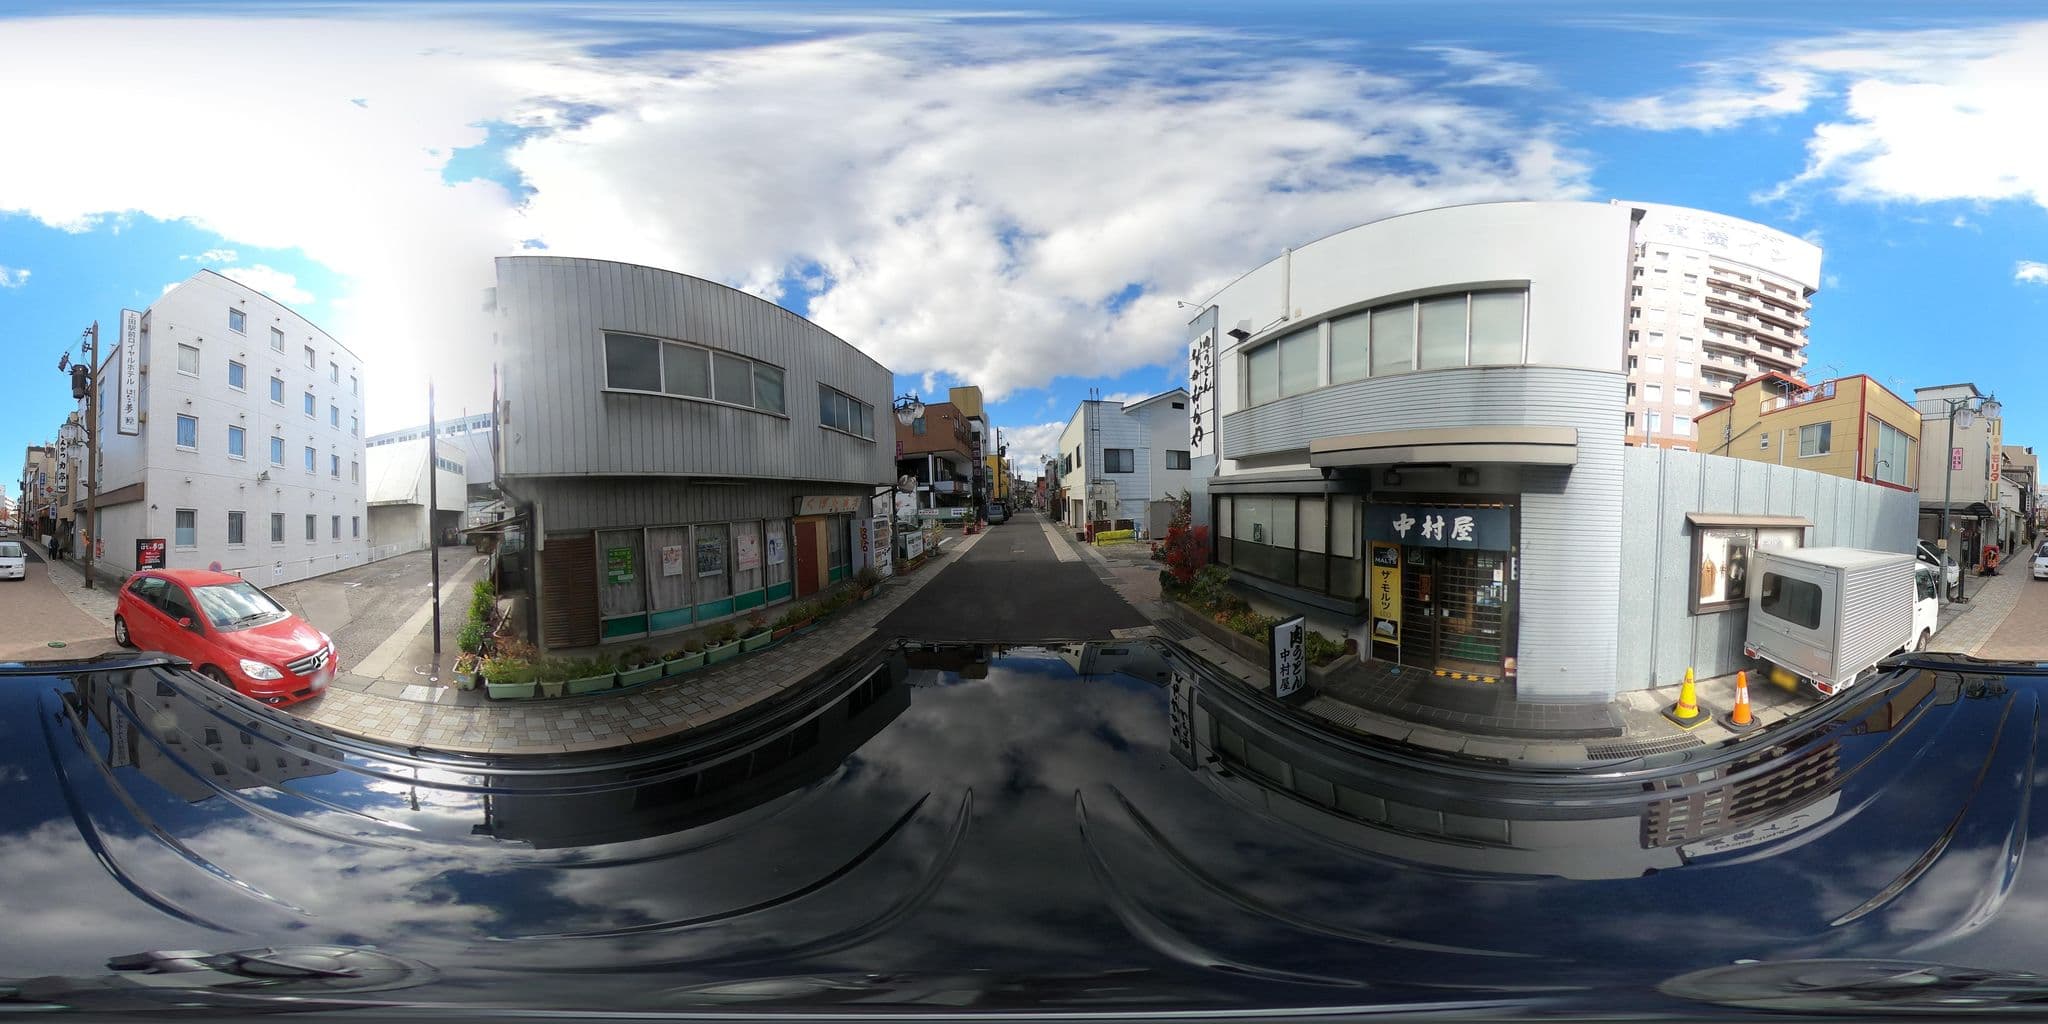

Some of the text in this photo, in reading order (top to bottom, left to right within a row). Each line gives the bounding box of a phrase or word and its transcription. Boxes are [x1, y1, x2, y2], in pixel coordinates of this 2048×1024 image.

[1393, 513, 1475, 541] 中村屋
[1381, 570, 1391, 610] ザ・モルツ
[1280, 648, 1291, 691] 中村屋
[1290, 625, 1302, 691] 肉うどん
